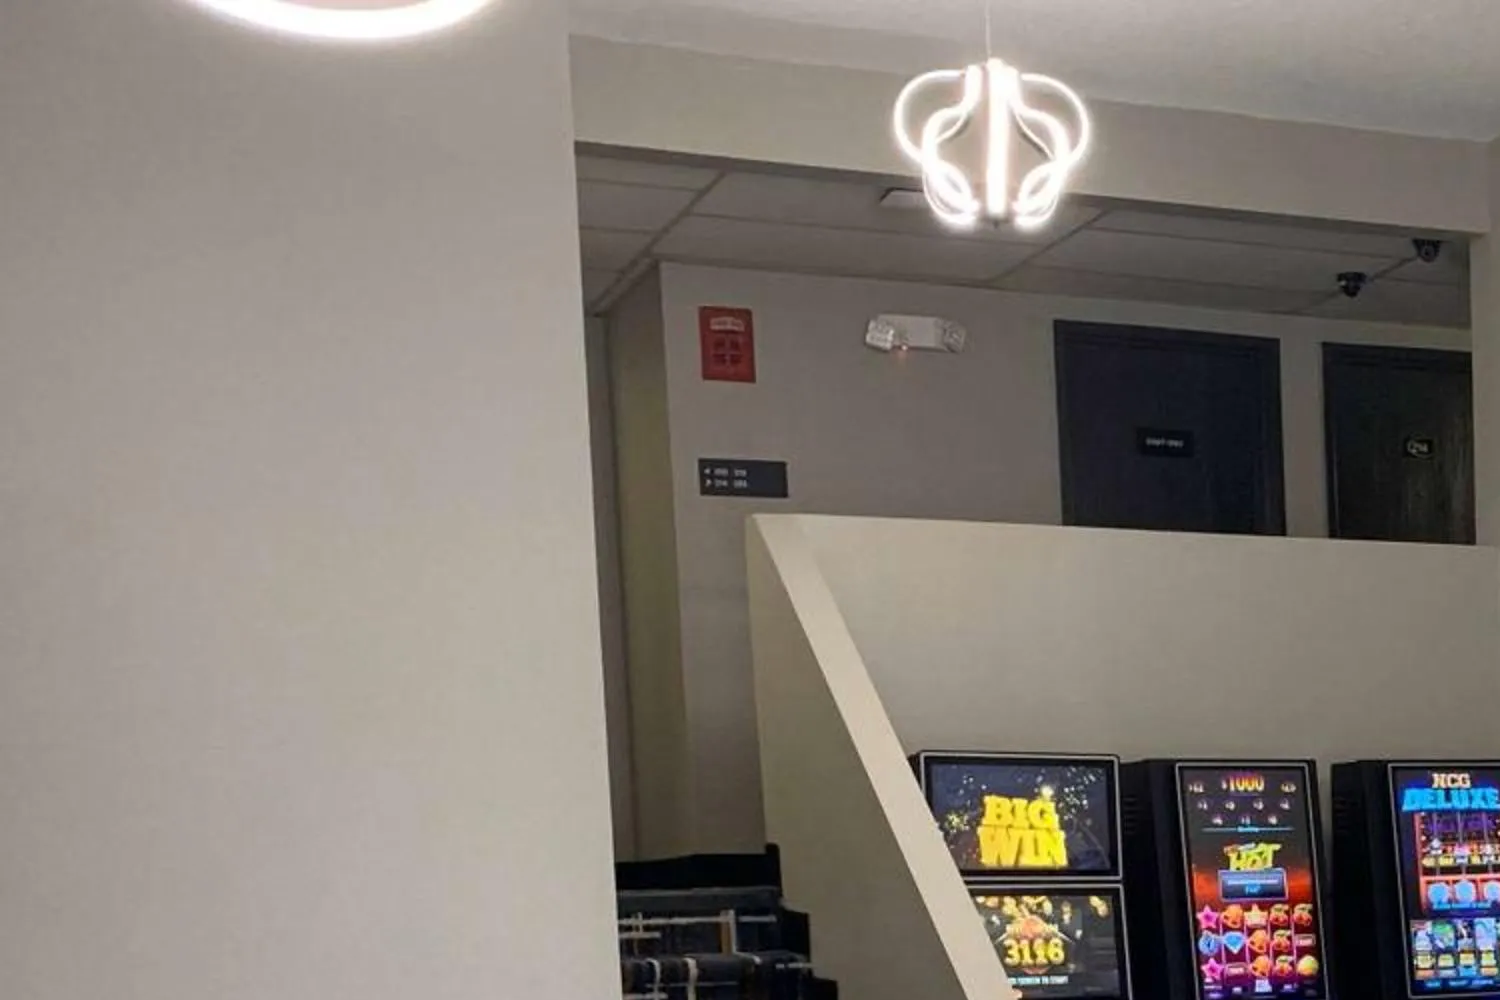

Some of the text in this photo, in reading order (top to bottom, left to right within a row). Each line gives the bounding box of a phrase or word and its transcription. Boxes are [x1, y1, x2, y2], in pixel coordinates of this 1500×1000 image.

[1431, 772, 1472, 789] NCG
[981, 794, 1060, 829] BIG
[976, 826, 1068, 869] WIN
[1228, 843, 1282, 873] HOT
